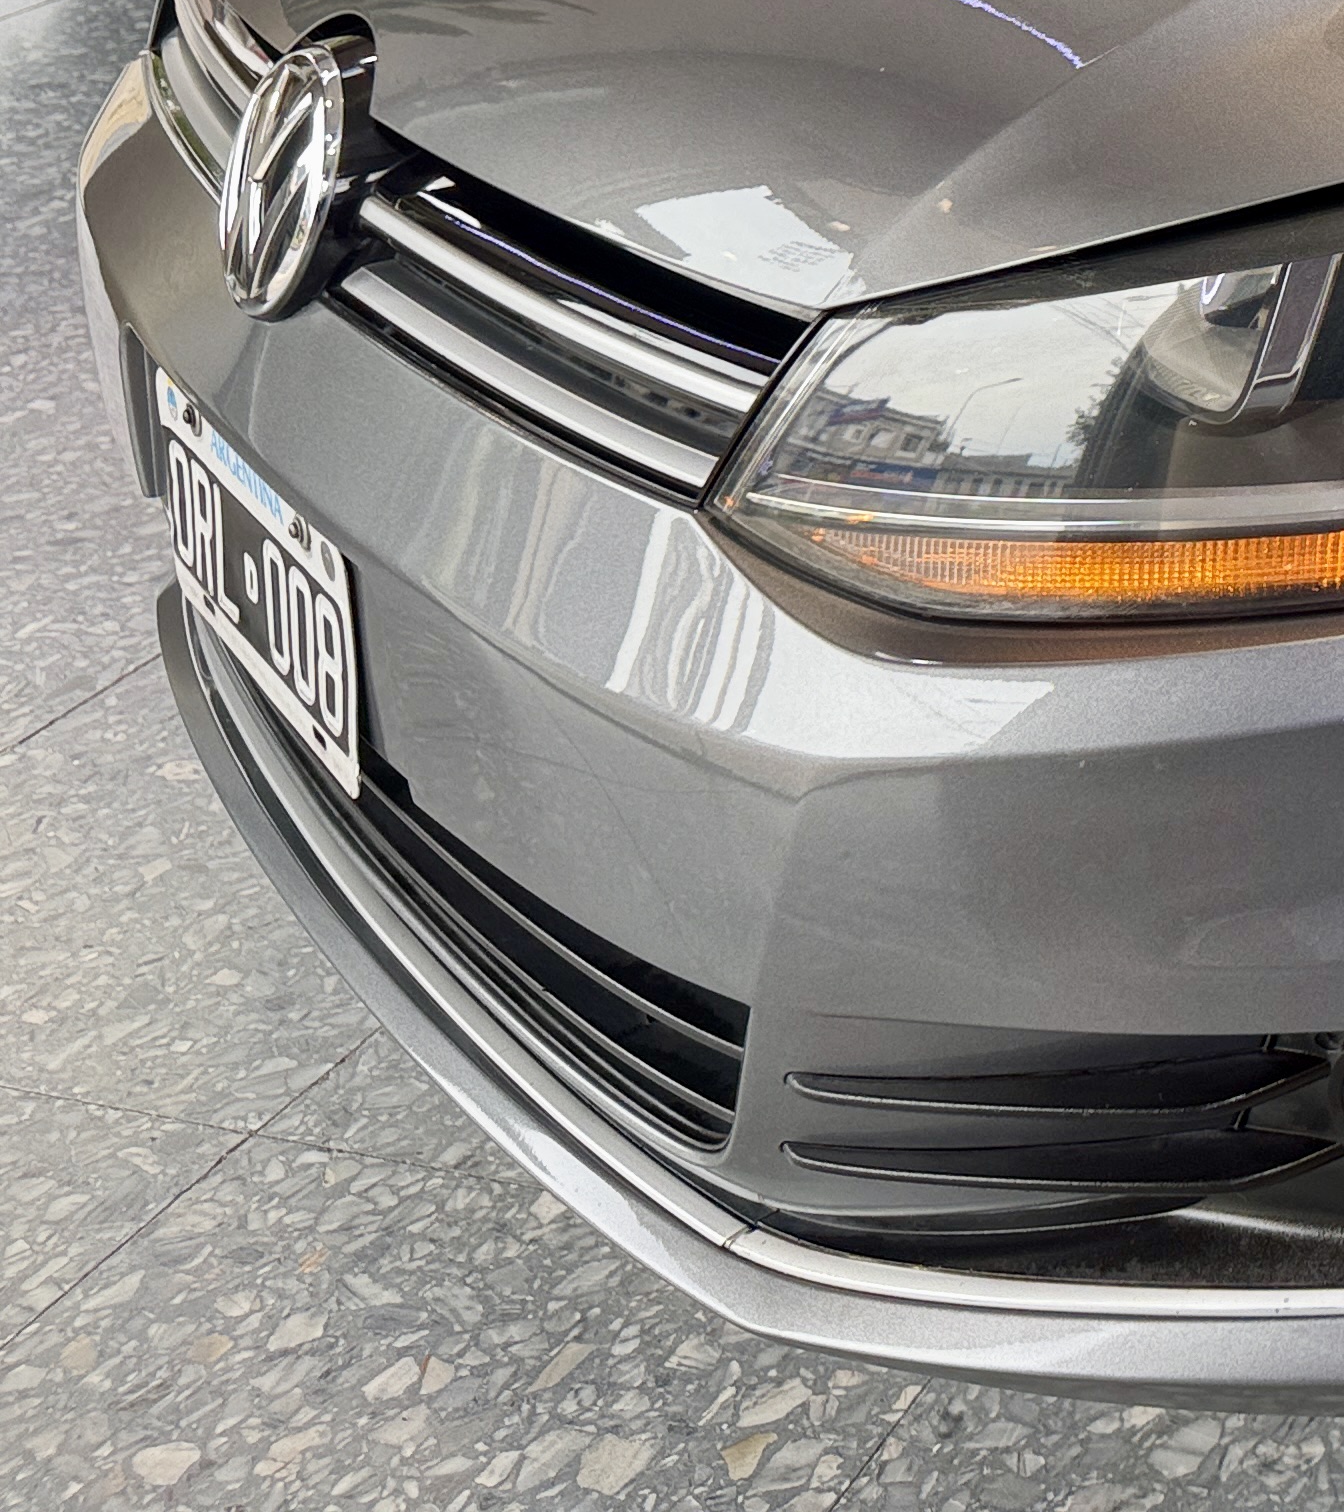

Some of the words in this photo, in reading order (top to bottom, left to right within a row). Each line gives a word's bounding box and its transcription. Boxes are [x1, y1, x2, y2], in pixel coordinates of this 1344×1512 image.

[210, 429, 284, 527] ARGENTINA
[169, 440, 240, 624] ORL
[263, 539, 344, 738] 008
